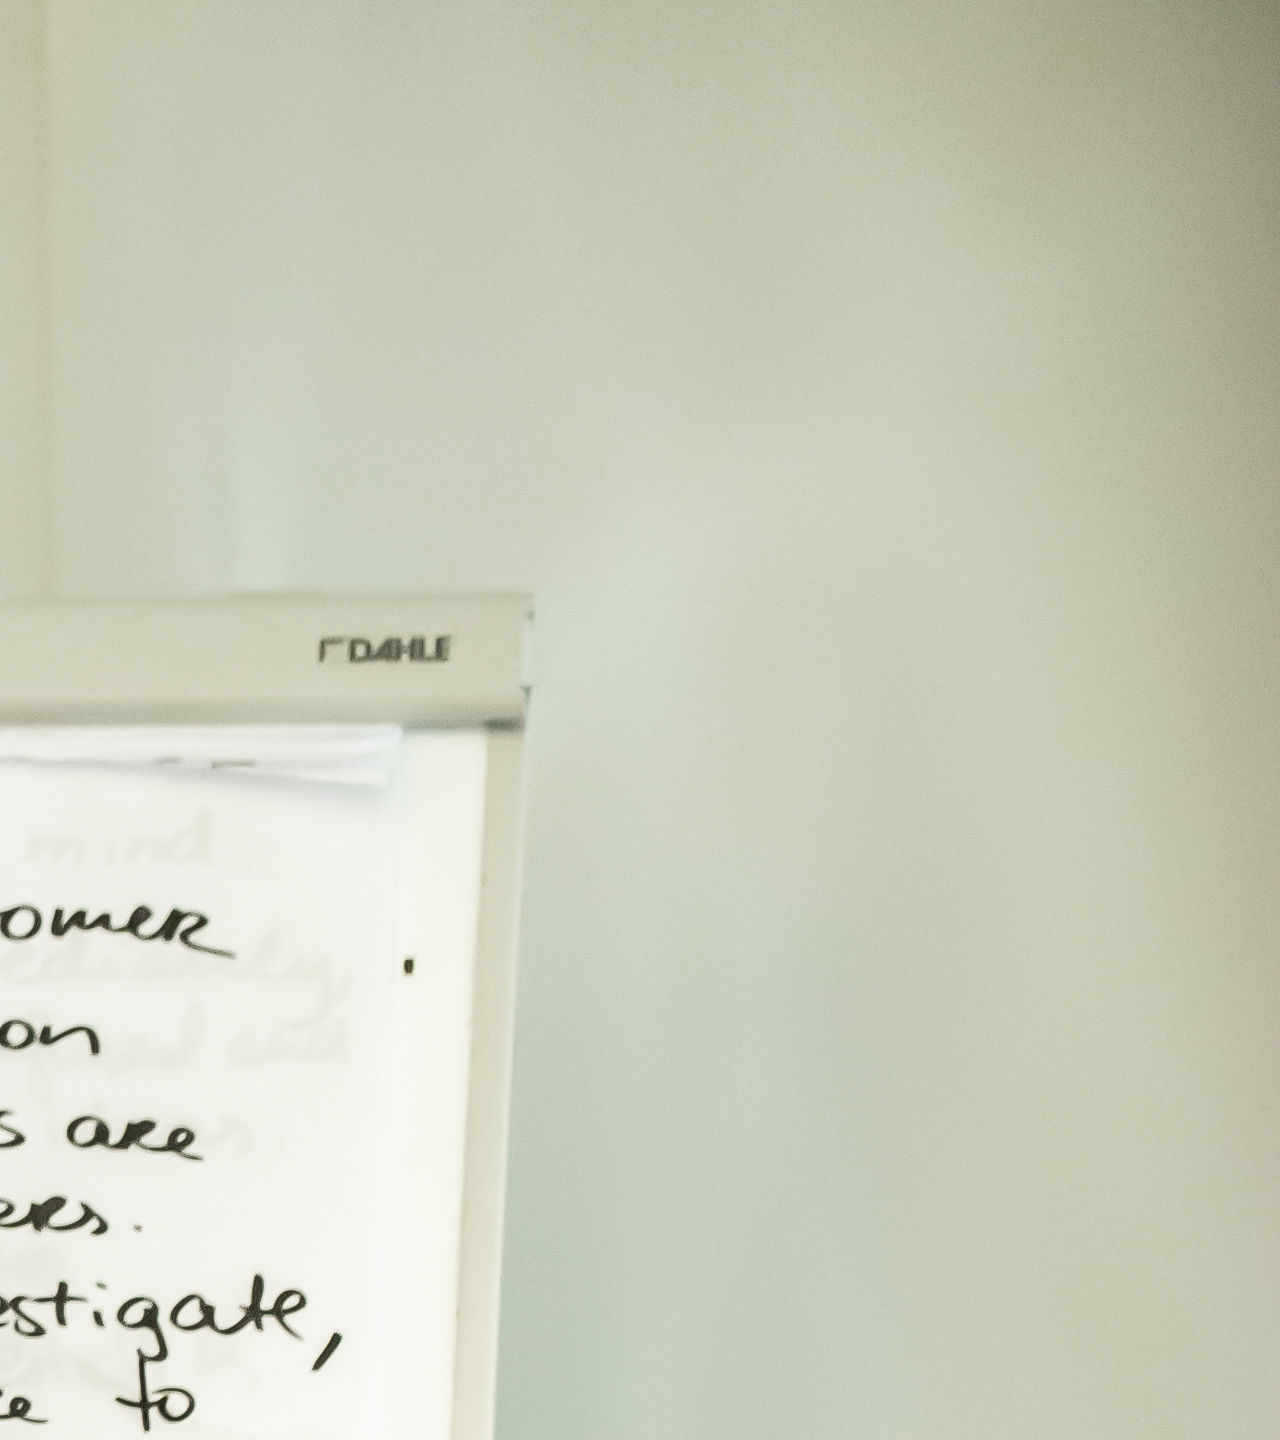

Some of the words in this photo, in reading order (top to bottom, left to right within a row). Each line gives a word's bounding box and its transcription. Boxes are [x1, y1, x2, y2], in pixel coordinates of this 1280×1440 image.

[347, 633, 450, 663] DAHLE
[65, 1114, 206, 1162] are
[114, 1360, 197, 1433] to
